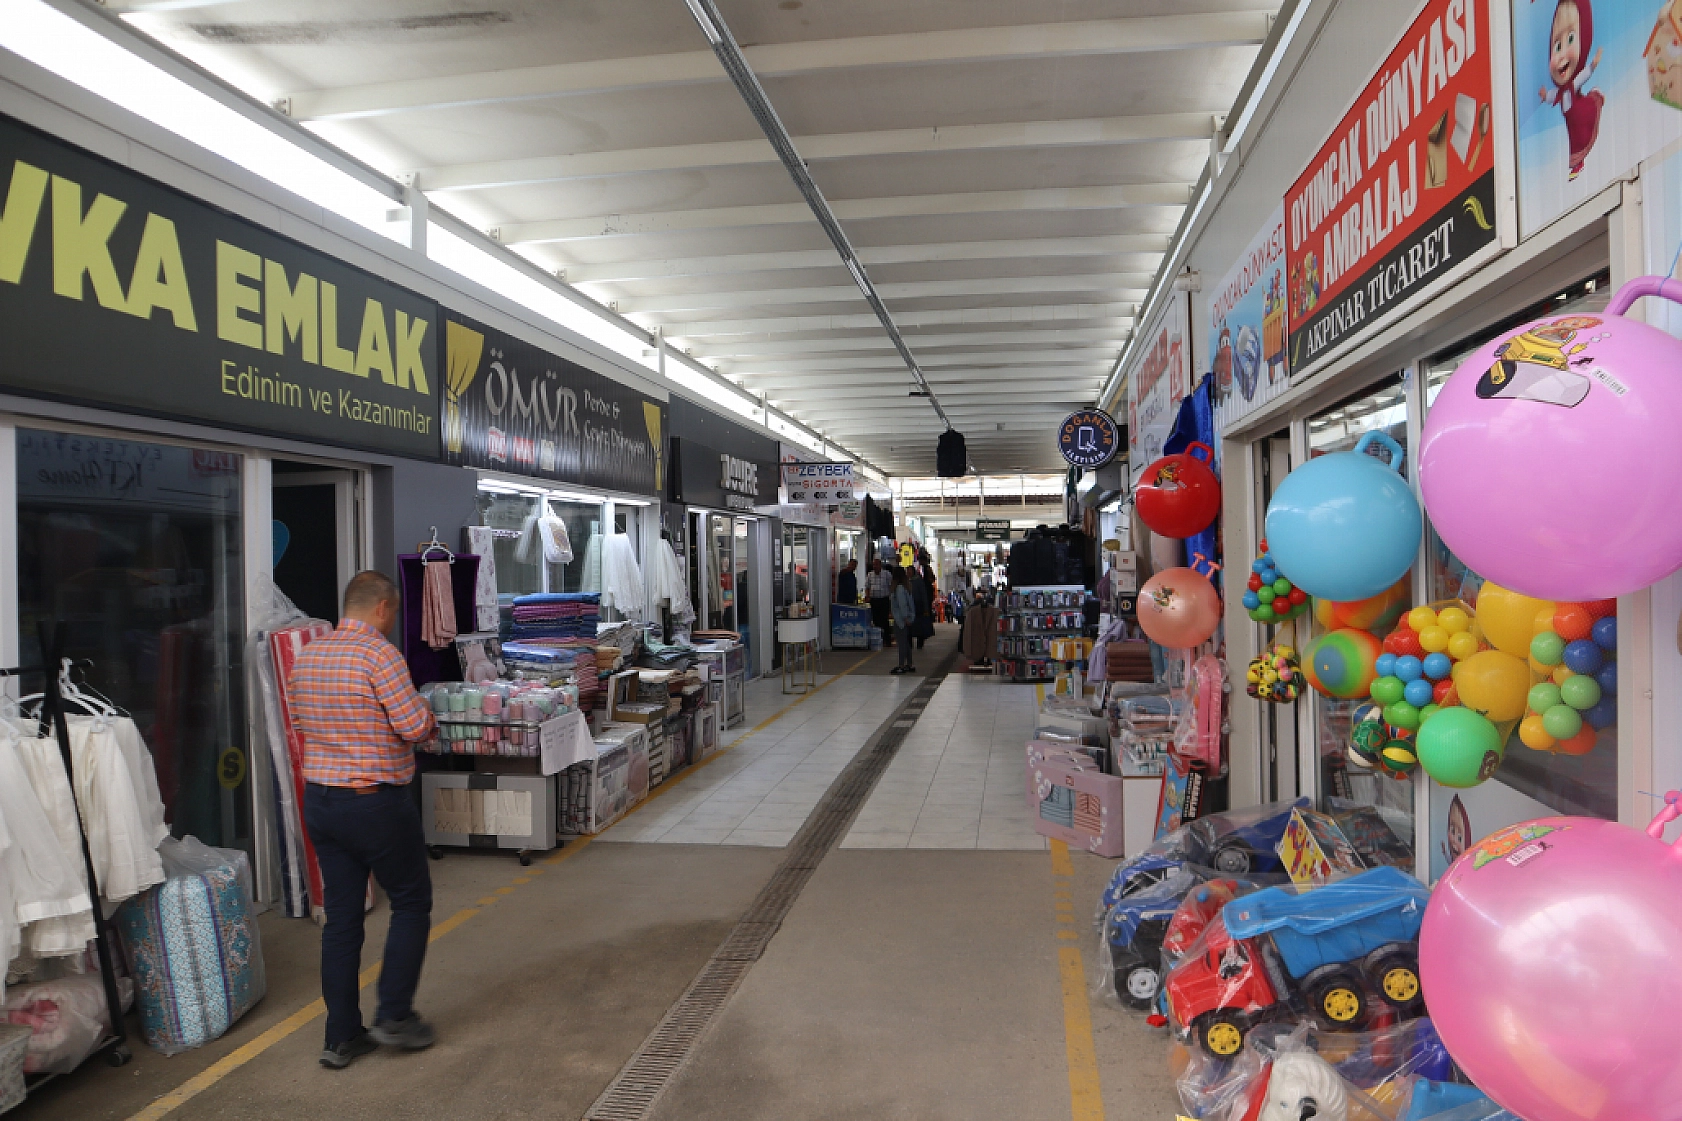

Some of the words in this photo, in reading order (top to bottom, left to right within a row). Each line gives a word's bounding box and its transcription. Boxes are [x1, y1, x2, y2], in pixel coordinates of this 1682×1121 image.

[1291, 119, 1363, 252] OYUNCAK
[1366, 0, 1476, 171] DÜNYASI
[1322, 139, 1418, 291] AMBALAJ
[216, 239, 431, 395] EMLAK
[1305, 307, 1366, 358] AKPINAR
[1367, 217, 1454, 315] TİCARET
[221, 359, 302, 408] Edinim
[310, 390, 332, 414] ve
[339, 389, 431, 435] Kazanımlar
[485, 347, 580, 437] ÖMÜR
[799, 465, 851, 477] ZEYBEK
